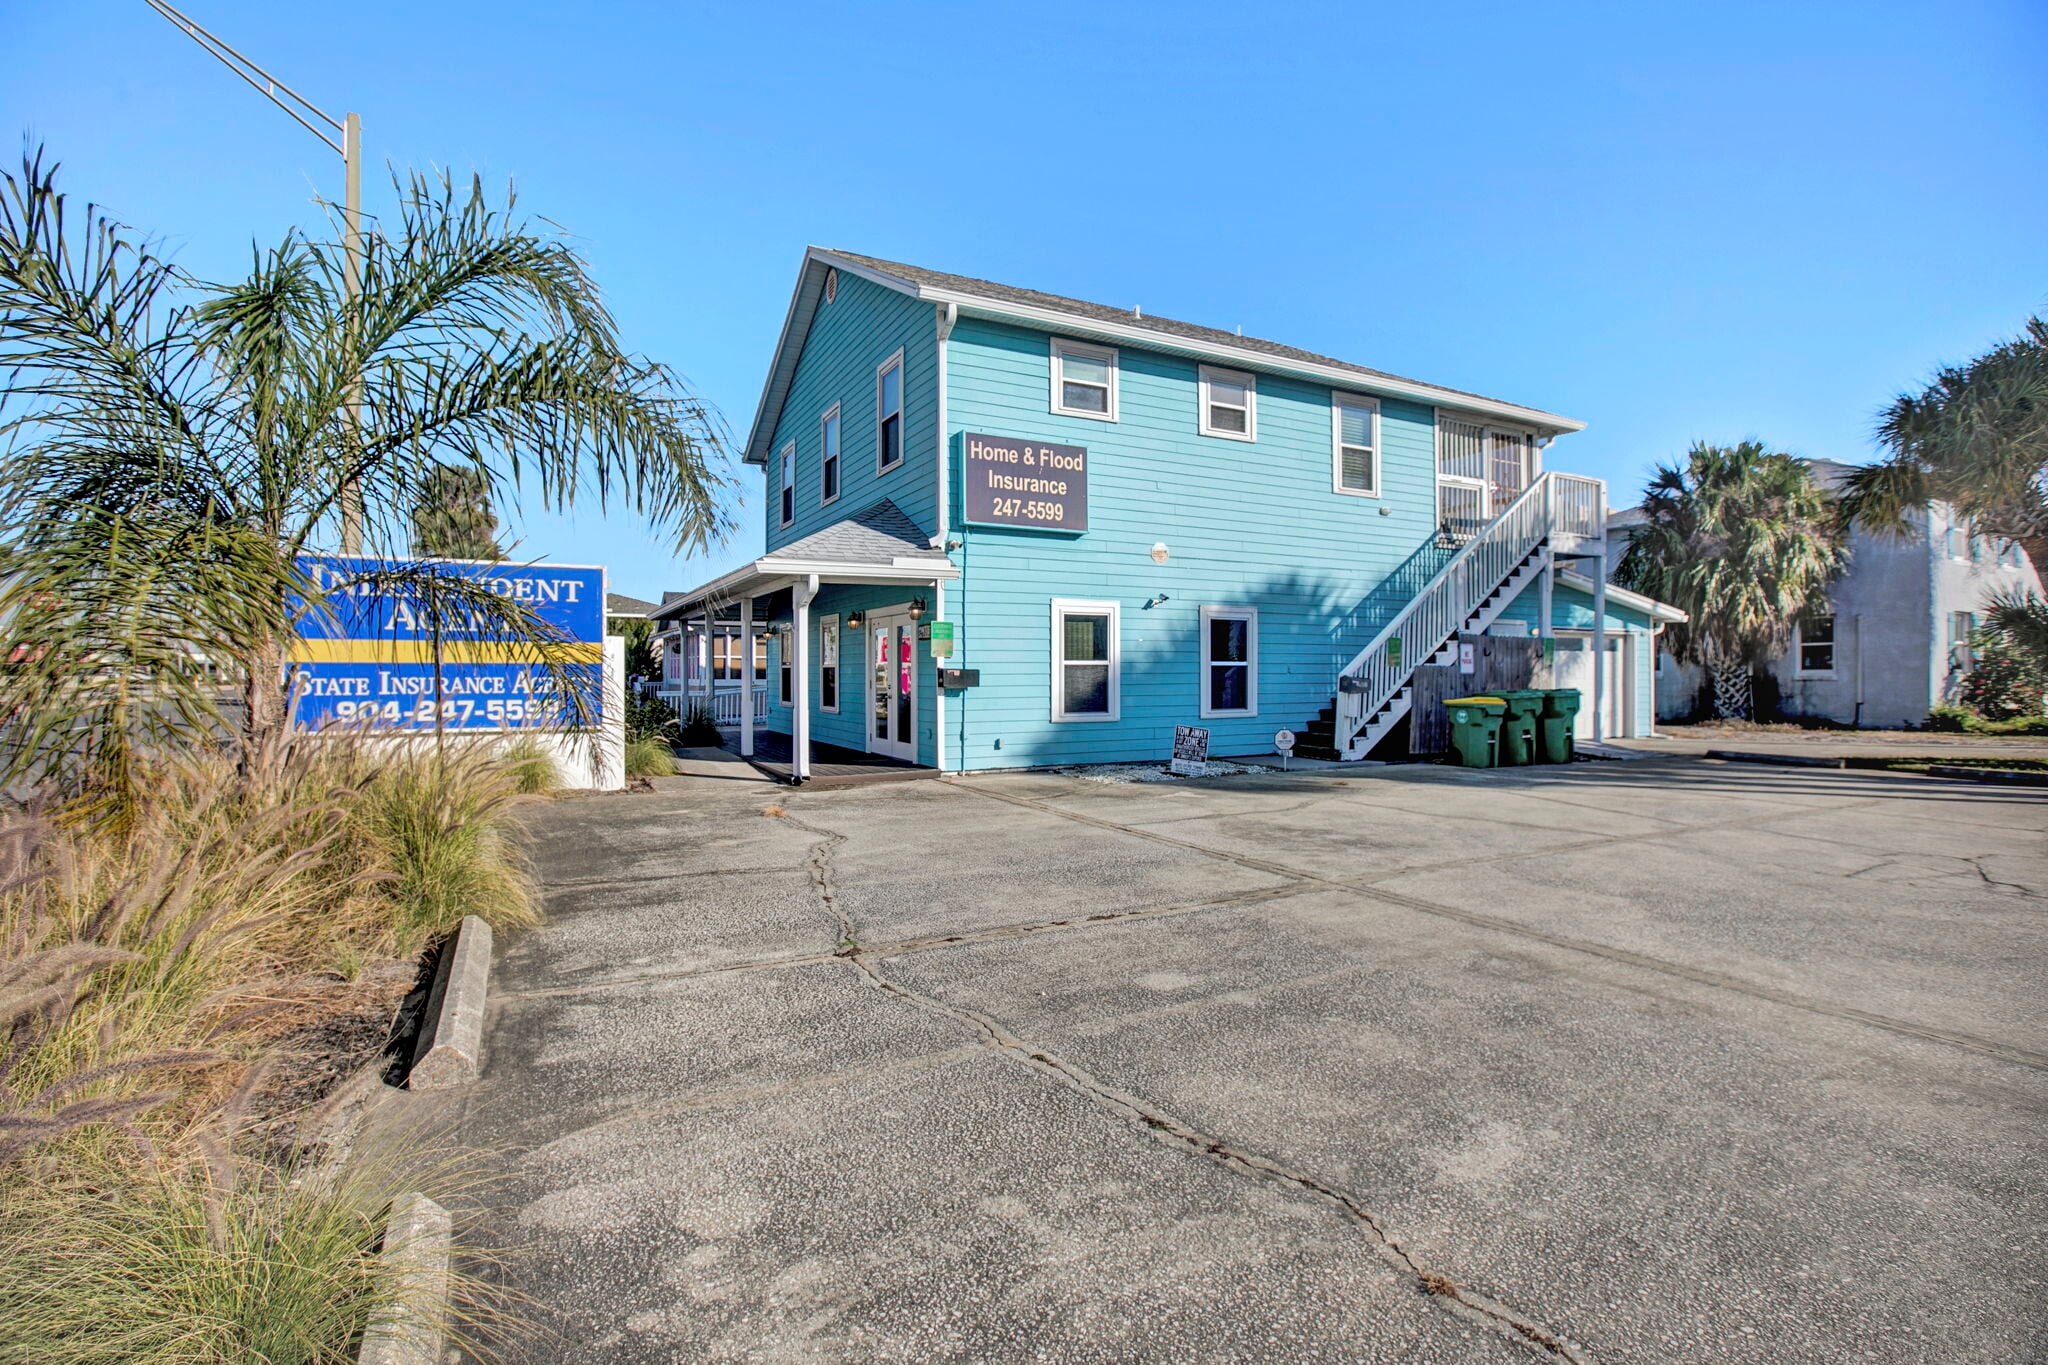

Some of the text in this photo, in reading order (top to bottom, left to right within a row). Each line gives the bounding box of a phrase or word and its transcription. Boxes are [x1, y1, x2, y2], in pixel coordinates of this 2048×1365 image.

[970, 440, 1083, 472] Home & Flood
[988, 469, 1067, 496] Insurance
[993, 497, 1064, 521] 247-5599
[1177, 726, 1190, 736] TOW
